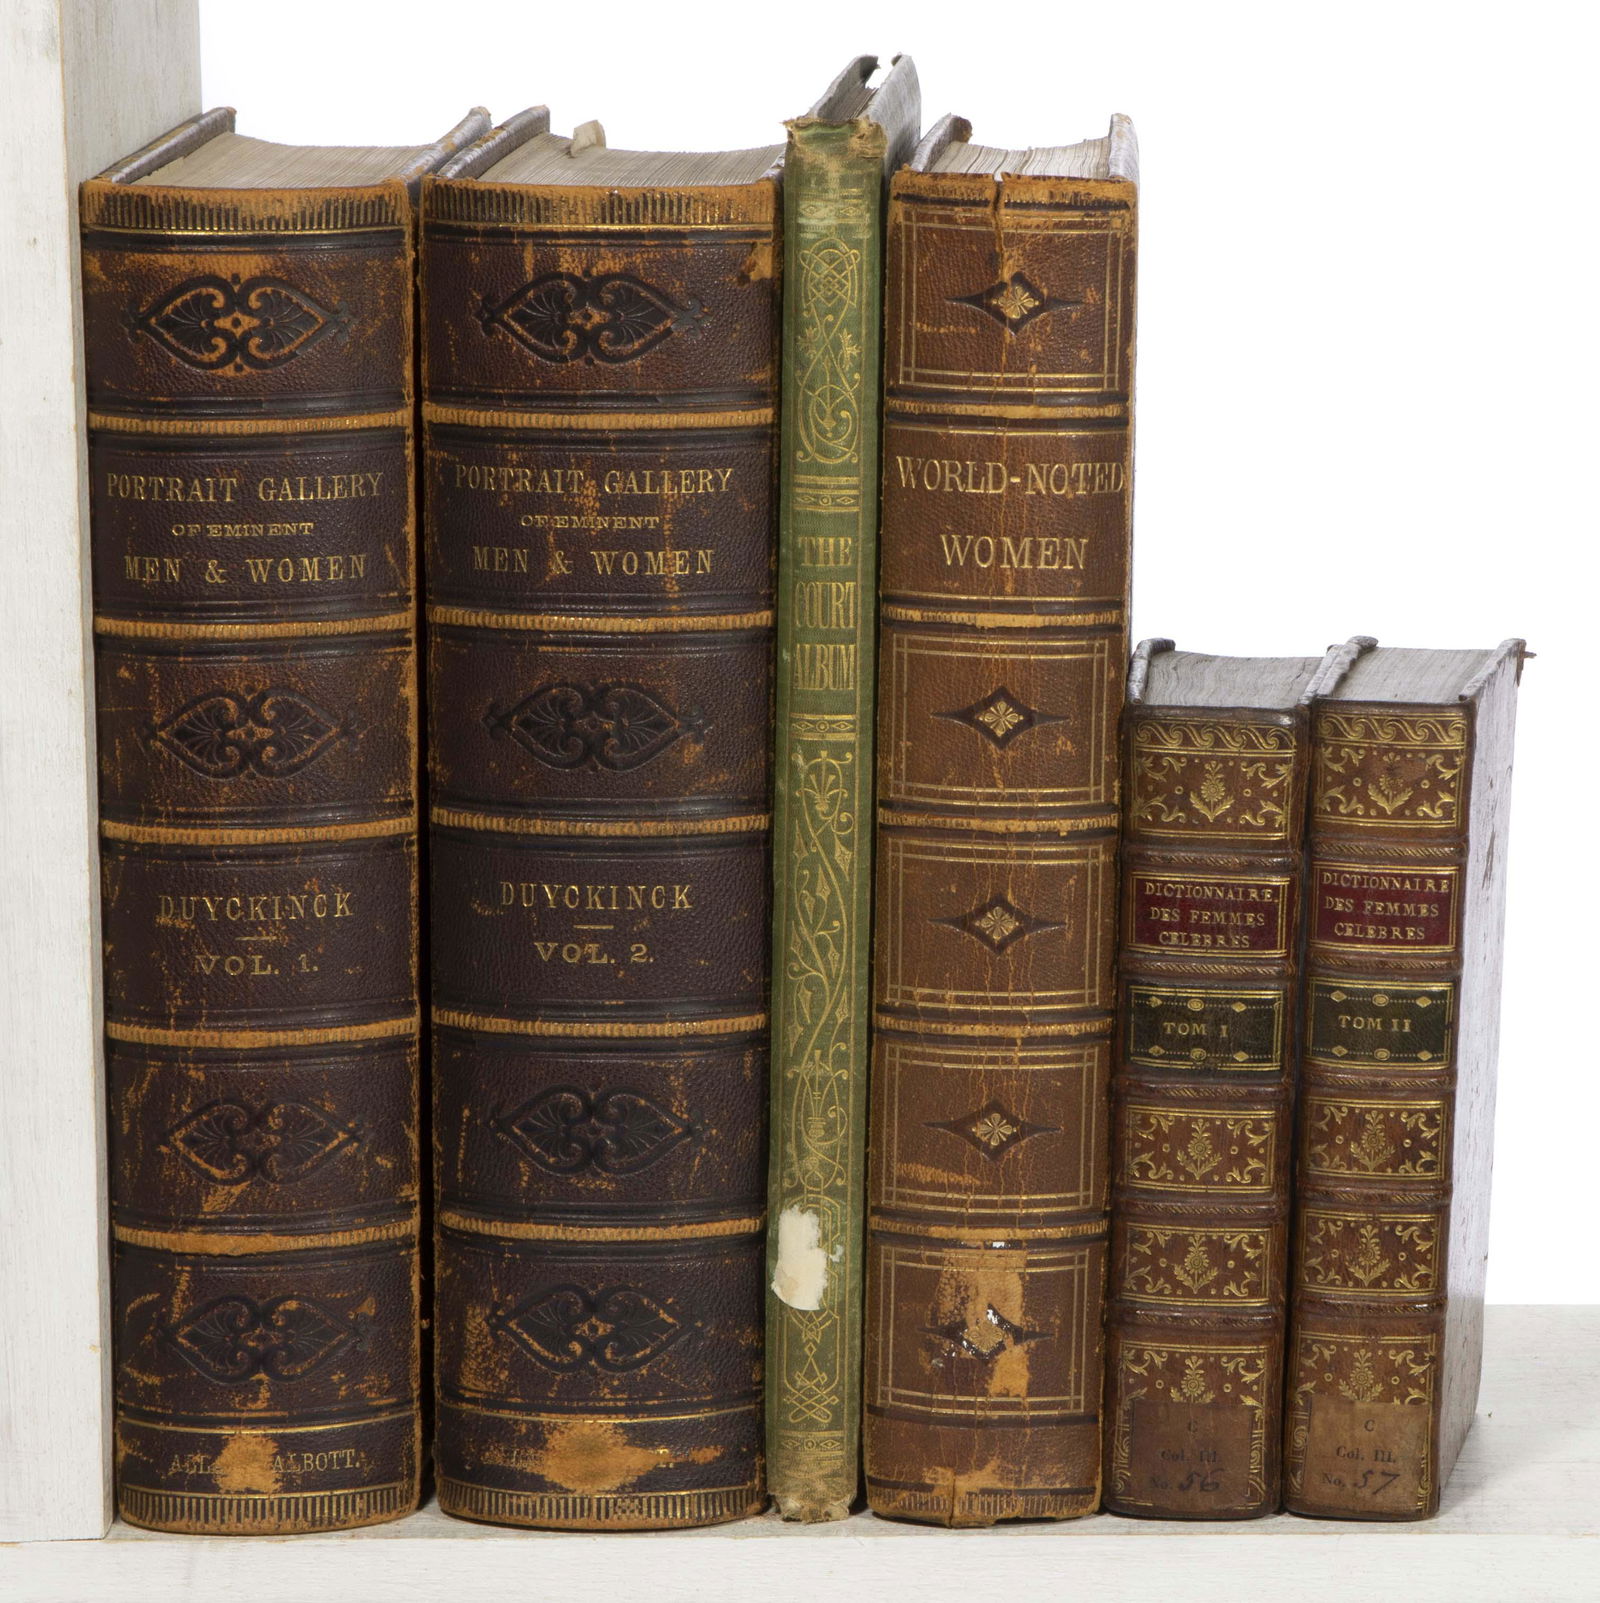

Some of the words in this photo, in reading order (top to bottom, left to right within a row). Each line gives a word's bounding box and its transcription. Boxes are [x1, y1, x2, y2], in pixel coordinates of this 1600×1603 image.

[107, 473, 237, 502] PORTRAIT
[258, 472, 384, 501] GALLERY
[455, 464, 584, 494] PORTRAIT
[603, 468, 733, 494] GALLERY
[896, 456, 1125, 495] WORLD-NOTED
[172, 523, 201, 537] OF
[206, 522, 314, 537] EMINENT
[520, 515, 549, 529] OF
[555, 515, 660, 529] EMINENT
[473, 545, 529, 573] MEN
[551, 550, 573, 575] &
[591, 550, 714, 576] WOMEN
[799, 537, 852, 567] THE
[941, 534, 1089, 570] WOMEN
[124, 555, 182, 583] MEN
[205, 559, 227, 584] &
[246, 554, 367, 583] WOMEN
[795, 582, 856, 629] COURT
[794, 644, 856, 691] ALBUM
[1323, 872, 1450, 893] DICTIONNAIRE
[158, 892, 354, 921] DUYCKINCK
[500, 881, 693, 911] DUYCKINCK
[1325, 896, 1354, 912] DES
[1363, 900, 1439, 918] FEMMES
[1150, 907, 1181, 922] DES
[1190, 909, 1265, 927] FEMMES
[1159, 931, 1250, 949] CELEBRES
[1334, 922, 1425, 940] CELEBRES
[195, 953, 280, 976] VOL.
[534, 942, 616, 964] VOL.
[1163, 1022, 1208, 1036] TOM
[1220, 1024, 1229, 1038] I
[1338, 1015, 1383, 1031] TOM
[1391, 1018, 1412, 1032] II
[1363, 1419, 1375, 1432] C
